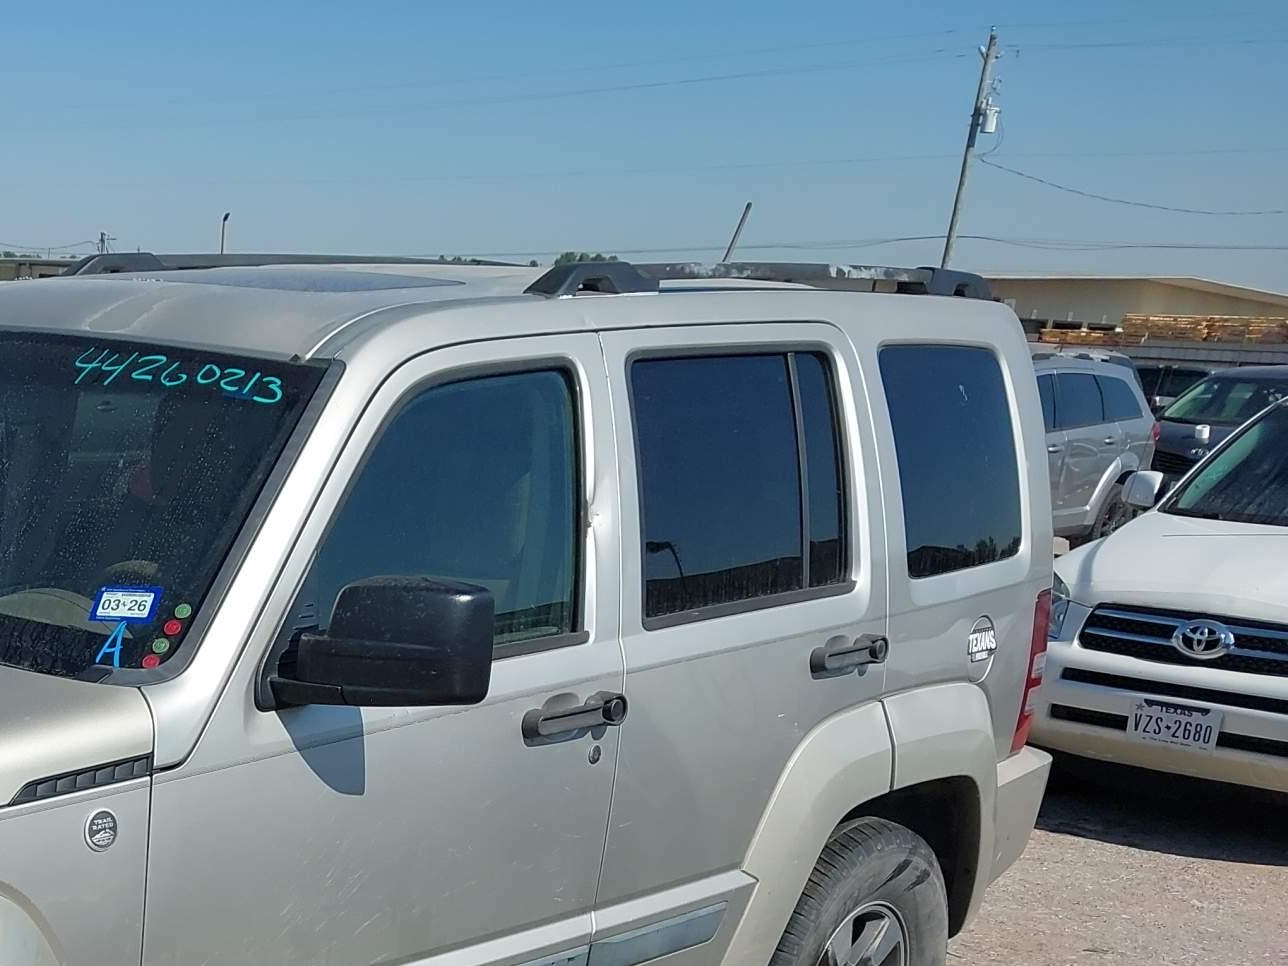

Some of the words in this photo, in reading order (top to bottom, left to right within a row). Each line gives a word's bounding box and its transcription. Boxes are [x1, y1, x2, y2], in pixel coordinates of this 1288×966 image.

[74, 346, 283, 403] 44260213
[101, 598, 121, 612] 03
[127, 599, 148, 613] 26
[95, 620, 124, 668] A
[968, 630, 997, 655] TEXANS
[1133, 712, 1164, 735] VZS
[1171, 719, 1213, 745] 2680
